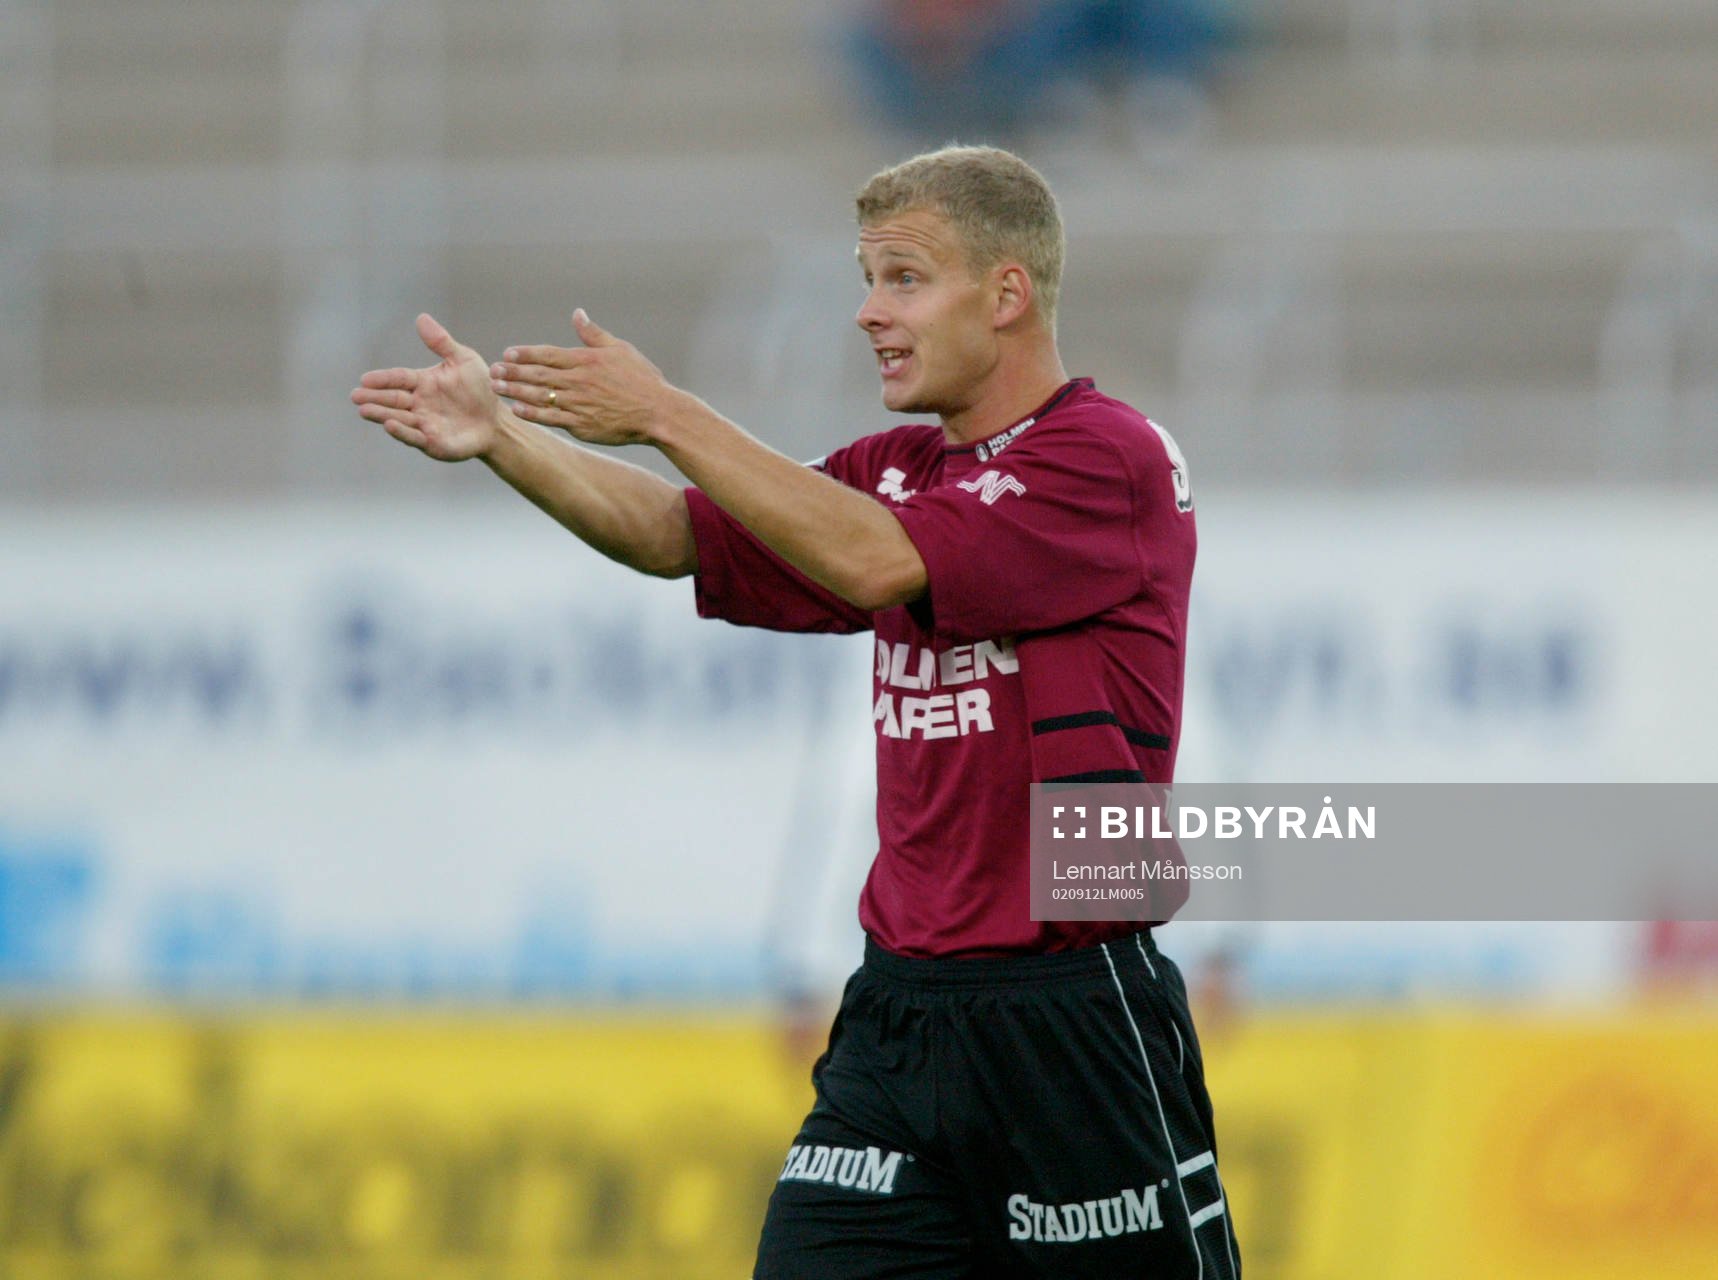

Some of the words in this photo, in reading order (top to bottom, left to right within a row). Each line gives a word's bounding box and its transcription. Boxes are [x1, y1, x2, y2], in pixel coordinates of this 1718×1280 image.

[873, 687, 995, 740] APER
[780, 1145, 903, 1193] TADIUM
[1007, 1184, 1164, 1243] STADIUM
